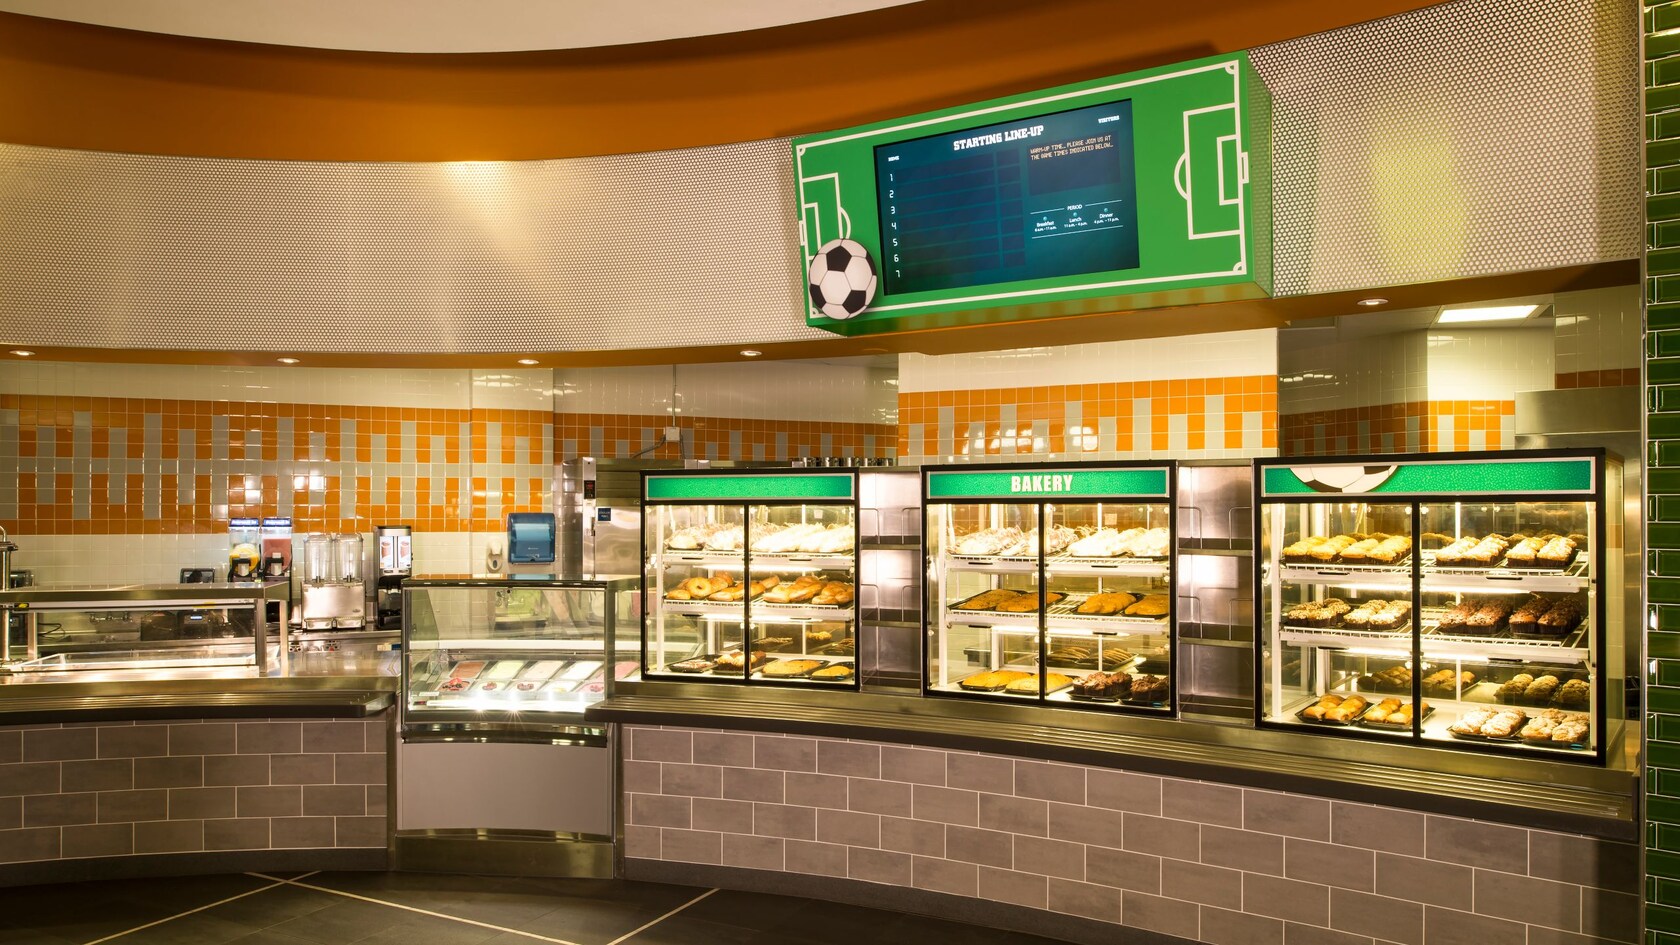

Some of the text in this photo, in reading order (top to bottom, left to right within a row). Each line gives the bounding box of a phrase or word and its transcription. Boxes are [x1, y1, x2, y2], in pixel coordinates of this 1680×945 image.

[953, 125, 1044, 151] STARTING LINE-UP
[1066, 140, 1084, 148] PLEASE
[1053, 149, 1069, 157] TIMES
[1069, 144, 1095, 154] INDICATED
[889, 173, 894, 182] 1
[889, 189, 894, 199] 2
[890, 206, 896, 215] 3
[891, 222, 897, 230] 4
[892, 238, 898, 247] 5
[893, 254, 899, 262] 6
[895, 270, 901, 278] 7
[1011, 474, 1073, 492] BAKERY
